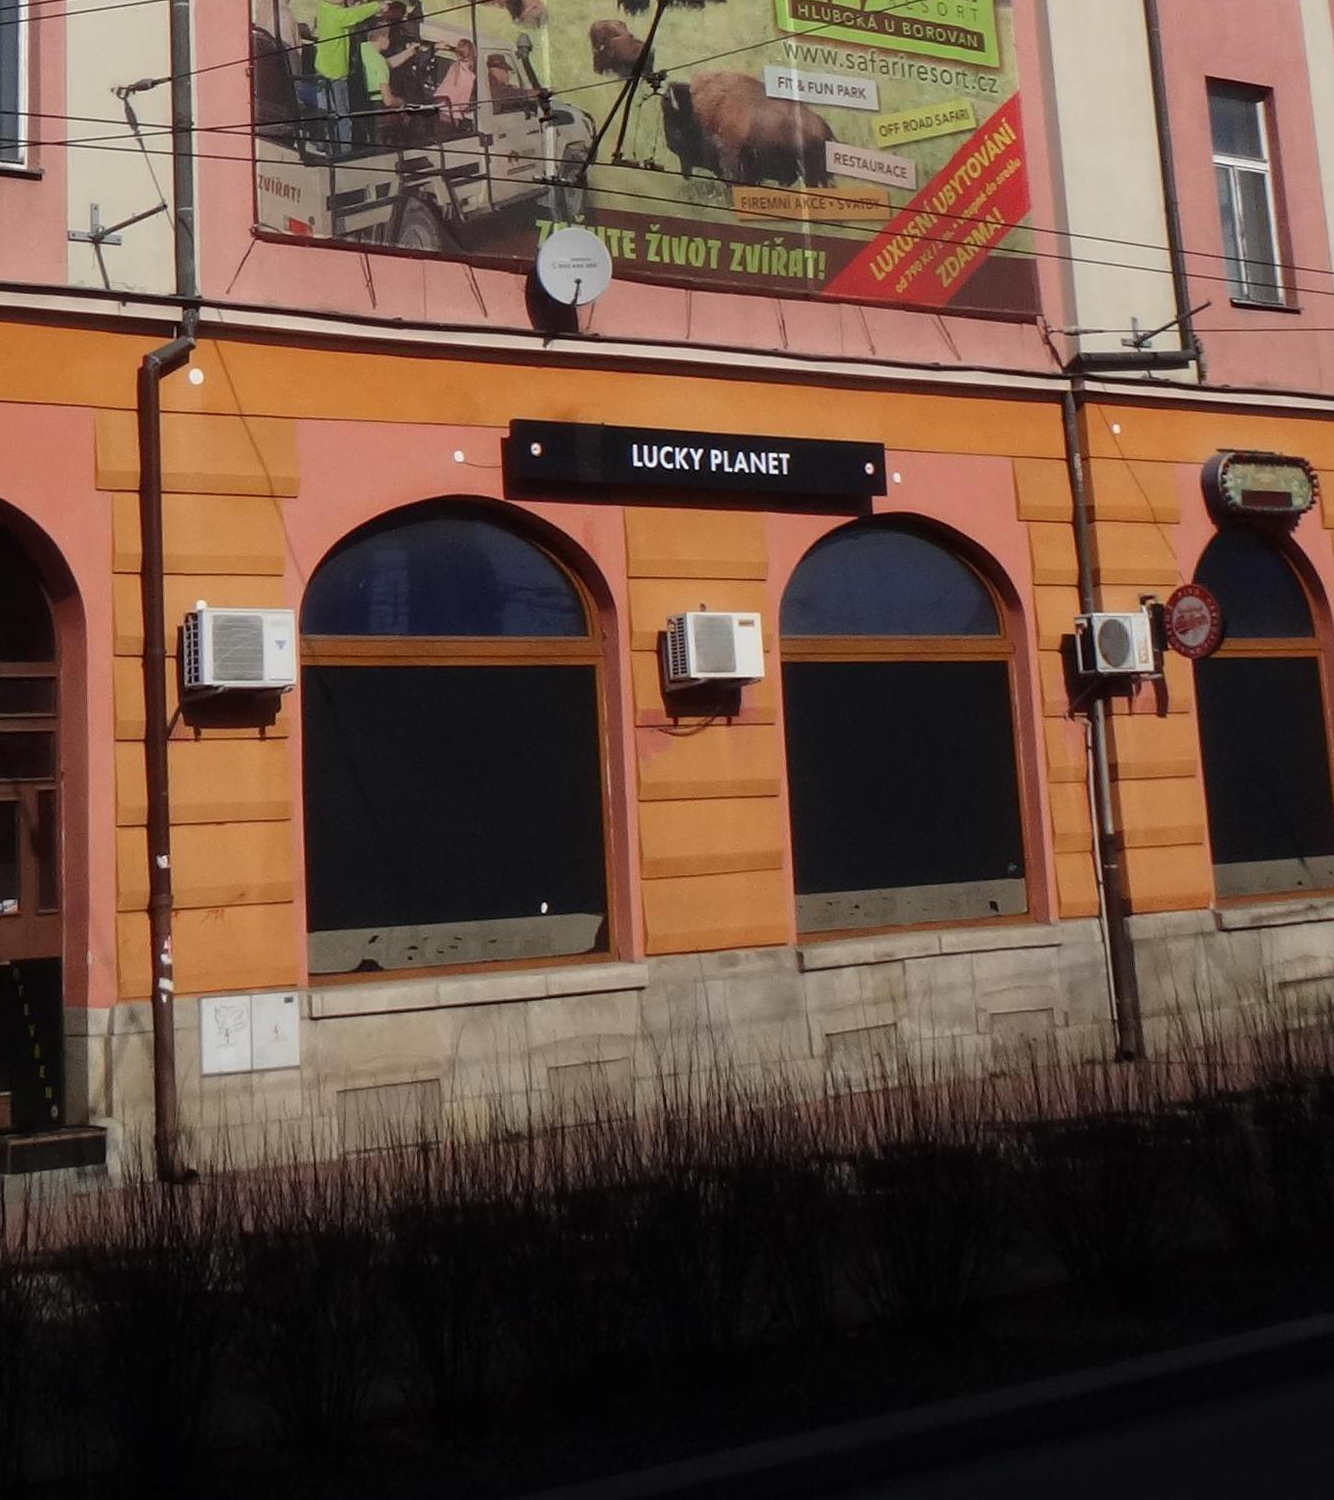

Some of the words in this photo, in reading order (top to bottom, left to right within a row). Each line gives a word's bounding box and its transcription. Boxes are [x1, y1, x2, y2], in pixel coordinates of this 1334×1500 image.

[797, 4, 876, 31] HLUBOKÁ
[884, 19, 896, 33] U
[902, 22, 979, 49] BOROVAN
[782, 40, 999, 94] www.safariresort.cz
[777, 76, 793, 91] FIT
[796, 78, 805, 92] &
[808, 80, 833, 95] FUN
[837, 84, 866, 100] PARK
[879, 122, 900, 137] OFF
[903, 116, 933, 132] ROAD
[935, 109, 970, 127] SAFARI
[833, 151, 907, 179] RESTAURACE
[741, 194, 791, 209] FIREMNÍ
[795, 197, 826, 210] AKCE
[870, 200, 938, 281] LUXUSNÍ
[932, 117, 1017, 214] UBYTOVÁNÍ
[645, 223, 722, 268] ŽIVOT
[729, 237, 826, 279] ZVÍŘAT!
[935, 207, 1005, 287] ZDARMA!
[896, 274, 908, 293] od
[631, 443, 703, 471] LUCKY
[710, 450, 791, 475] PLANET
